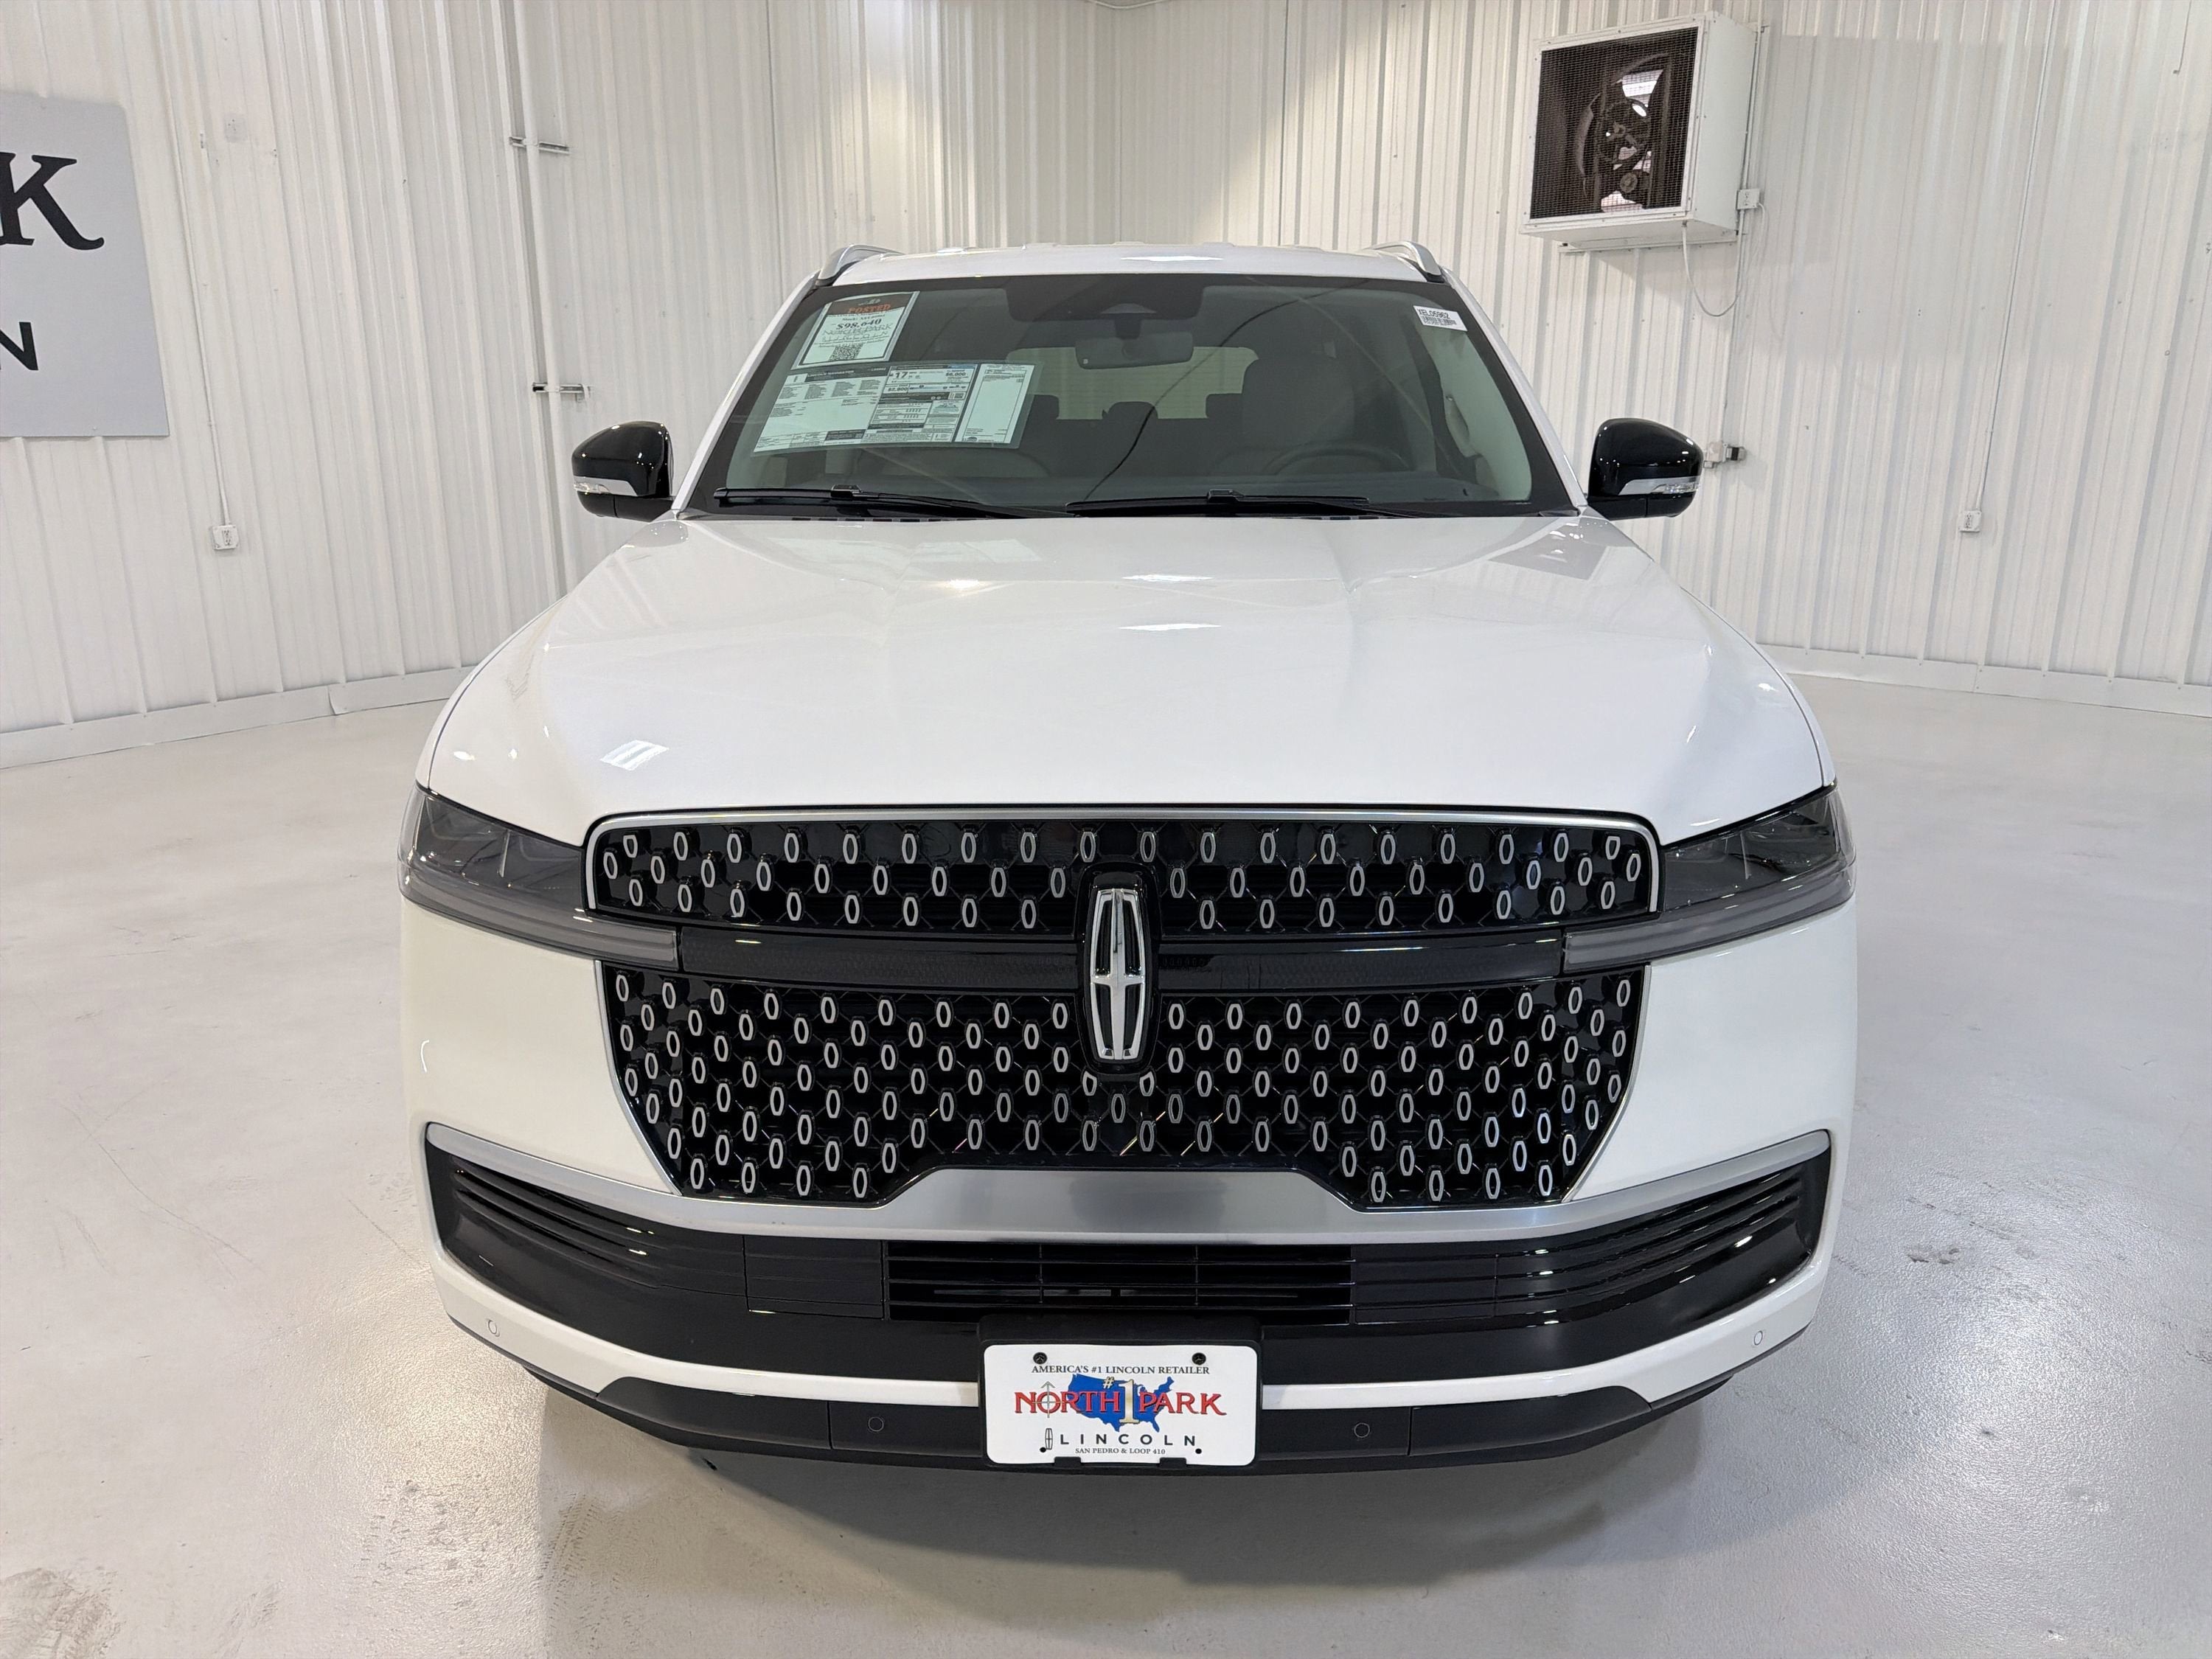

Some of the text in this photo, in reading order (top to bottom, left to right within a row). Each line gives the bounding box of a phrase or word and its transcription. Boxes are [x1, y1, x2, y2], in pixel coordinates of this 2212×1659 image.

[849, 303, 891, 313] POSTED
[1031, 1366, 1089, 1374] AMERICA'S
[1105, 1366, 1155, 1374] LINCOLN
[1158, 1366, 1211, 1374] RETAILER
[1014, 1391, 1228, 1416] NORTH PARK
[1060, 1433, 1196, 1446] LINCOLN
